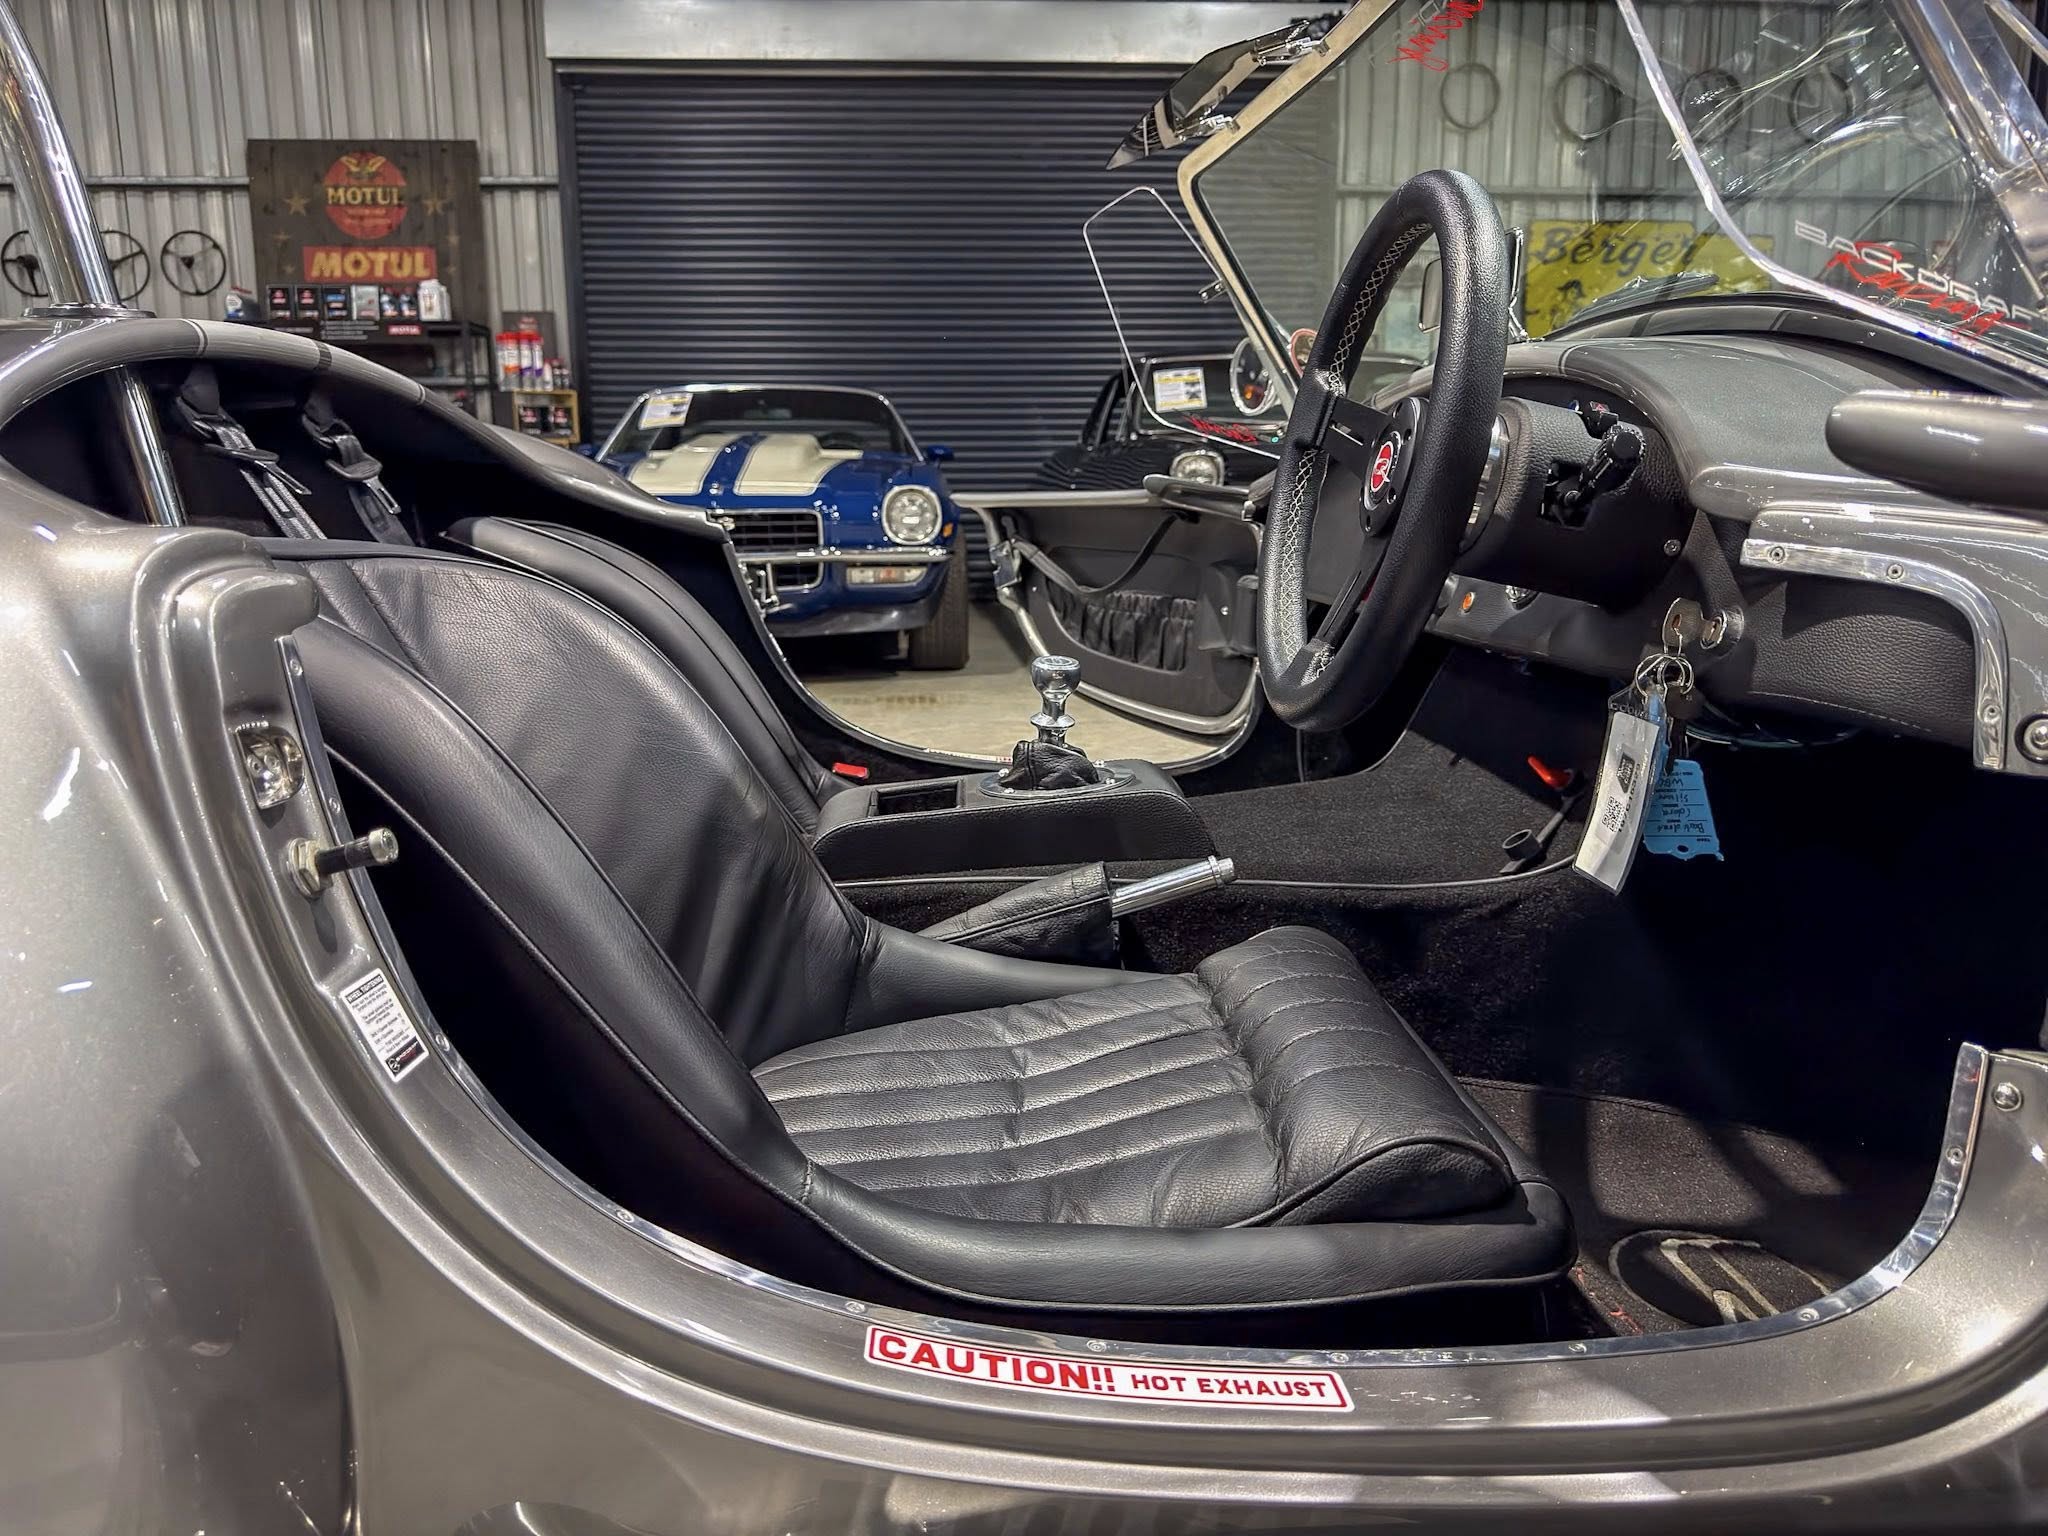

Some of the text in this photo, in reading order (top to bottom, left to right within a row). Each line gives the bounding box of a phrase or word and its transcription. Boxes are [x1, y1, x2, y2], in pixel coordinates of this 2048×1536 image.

[327, 187, 403, 205] MOTUL
[311, 250, 431, 278] MOTUL
[1530, 226, 1695, 277] Berger
[1795, 220, 2048, 321] BACKDRAF
[879, 1334, 1326, 1398] CAUTION!! HOT EXHAUST
